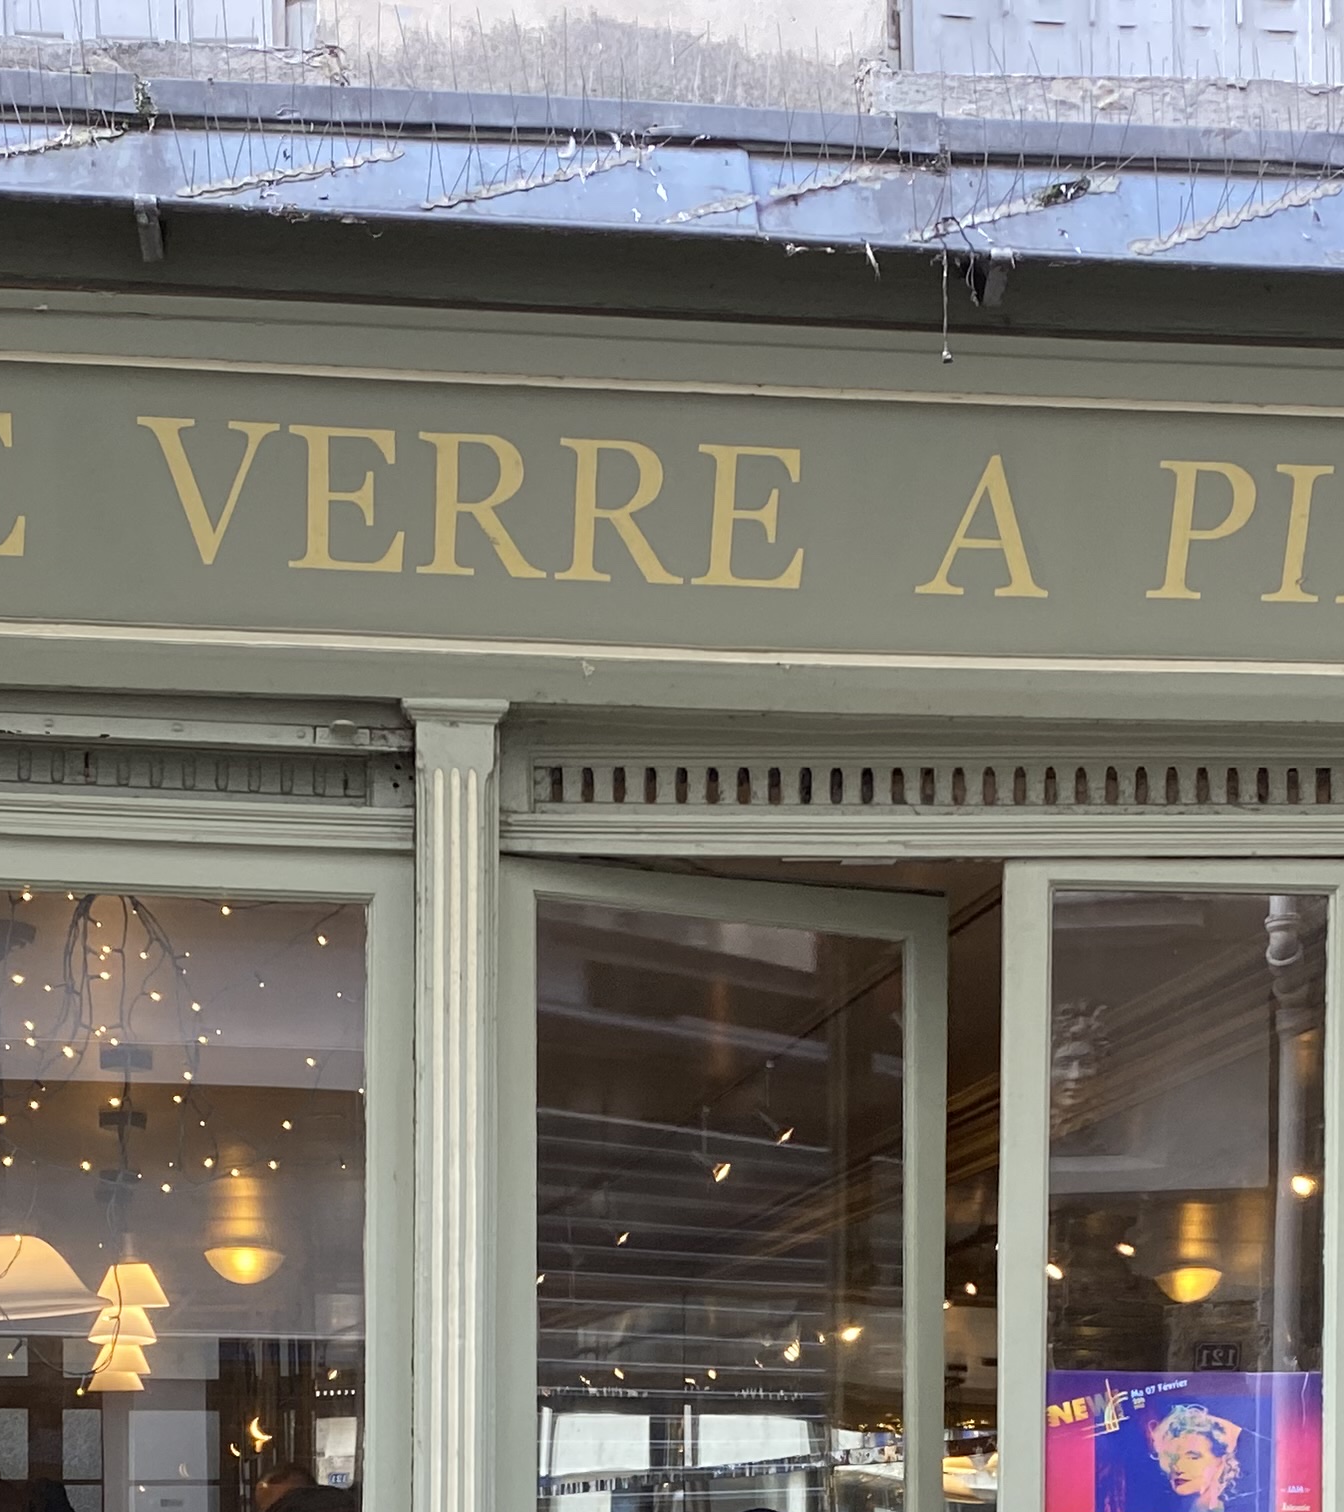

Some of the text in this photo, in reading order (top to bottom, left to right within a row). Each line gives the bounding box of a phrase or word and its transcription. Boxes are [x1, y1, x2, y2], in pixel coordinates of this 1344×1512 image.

[136, 415, 805, 592] VERRE
[913, 453, 1049, 600] A
[1145, 1385, 1156, 1396] 07
[1157, 1379, 1188, 1393] Février
